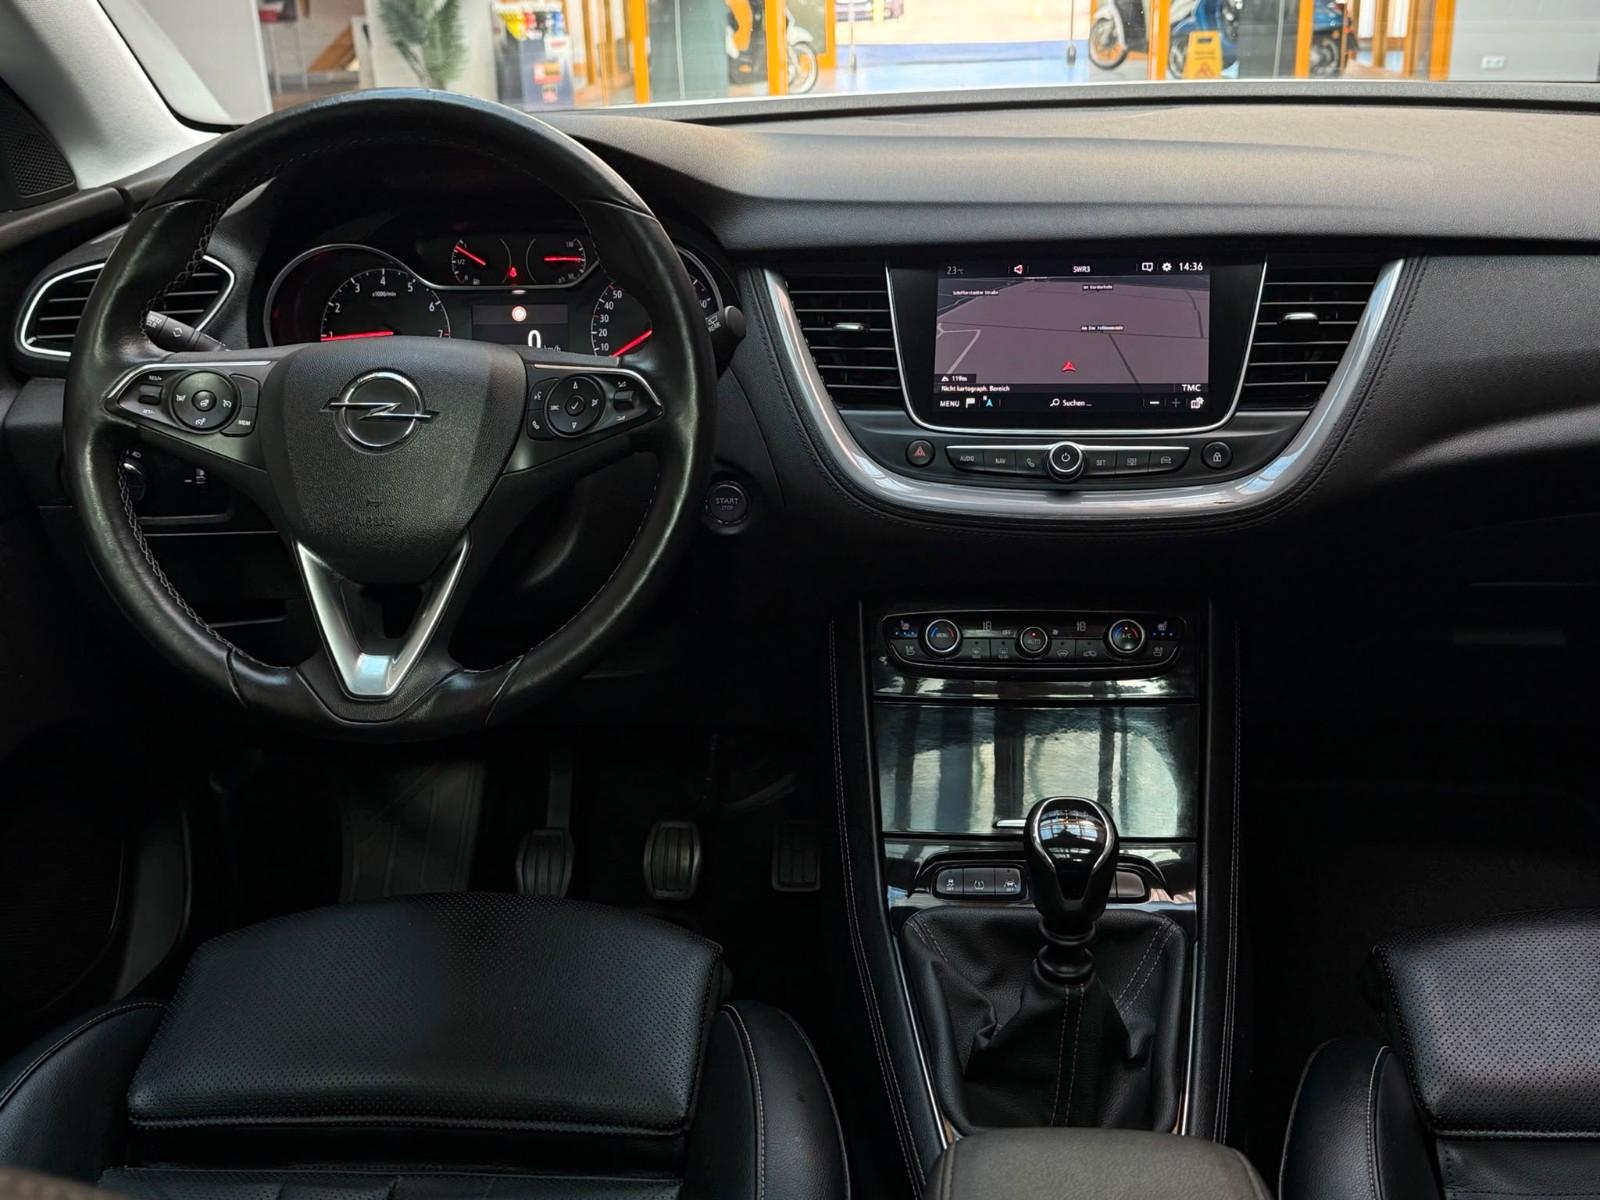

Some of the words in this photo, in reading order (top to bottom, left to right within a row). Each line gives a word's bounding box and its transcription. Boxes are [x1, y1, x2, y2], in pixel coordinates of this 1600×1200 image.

[1073, 265, 1091, 273] SWR3
[1179, 262, 1203, 271] 14:36
[380, 276, 386, 286] 4
[354, 282, 360, 293] 3
[407, 282, 413, 292] 5
[612, 290, 622, 299] 50
[335, 303, 341, 313] 2
[428, 302, 435, 312] 6
[604, 302, 614, 310] 40
[600, 314, 609, 323] 30
[437, 329, 443, 338] 7
[598, 328, 607, 337] 20
[528, 329, 541, 349] 0
[600, 342, 609, 351] 10
[1182, 384, 1201, 392] TMC
[715, 497, 738, 505] START
[1076, 621, 1086, 632] 18
